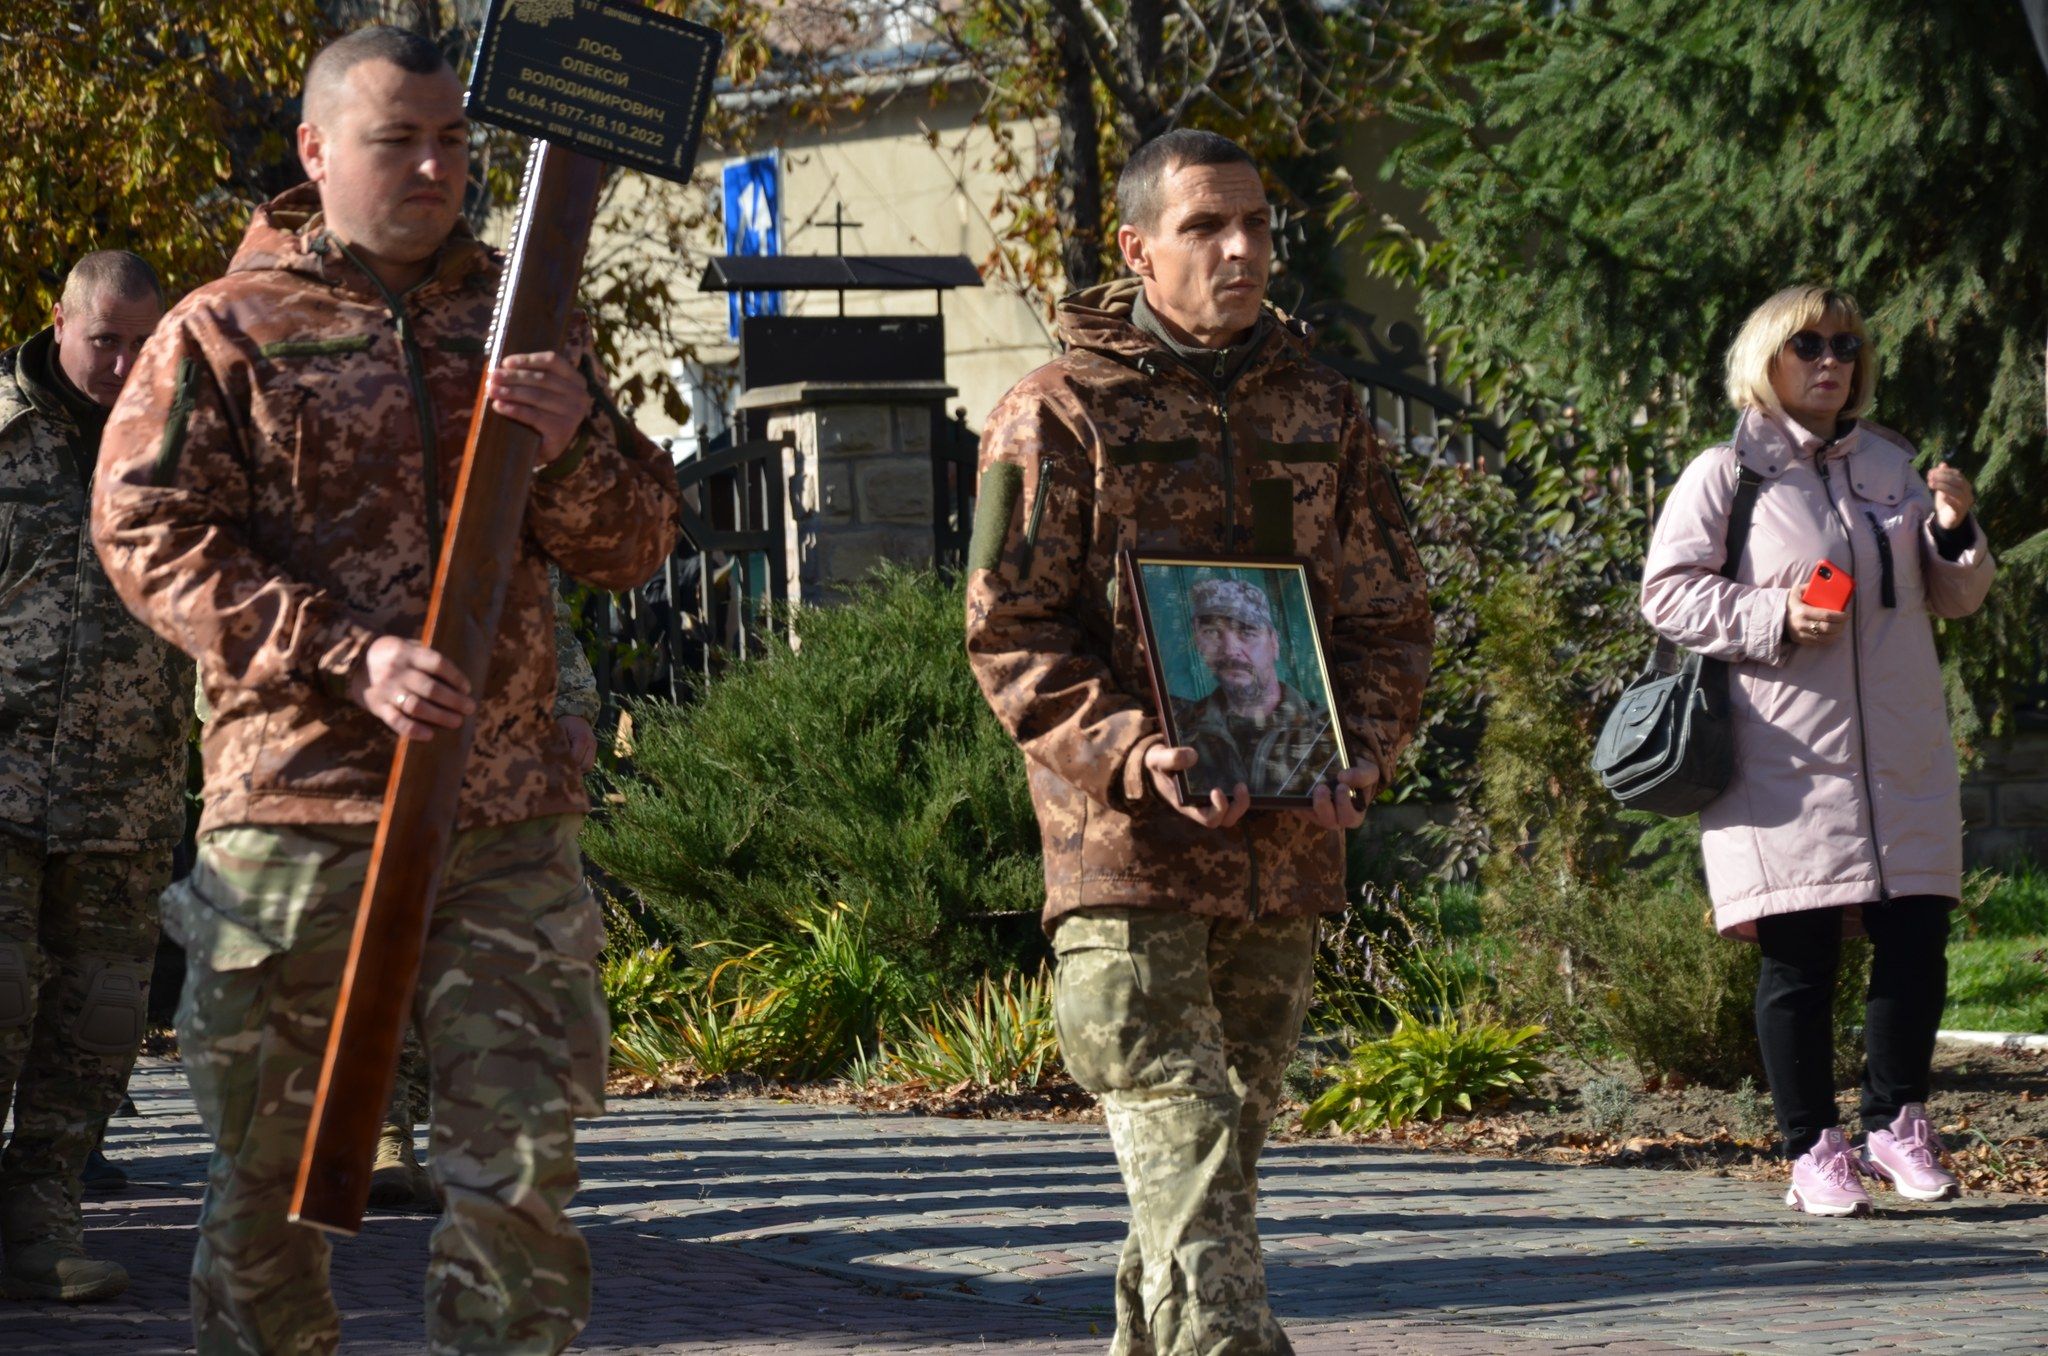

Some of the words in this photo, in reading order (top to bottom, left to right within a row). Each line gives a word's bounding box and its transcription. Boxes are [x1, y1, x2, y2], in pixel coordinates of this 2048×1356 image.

[578, 37, 622, 62] ЛОСЬ
[561, 56, 630, 88] ОЛЕКСІЙ
[520, 67, 666, 122] ВОЛОДИМИРОВИЧ
[507, 87, 665, 147] 04.04.1977-18.10.2022
